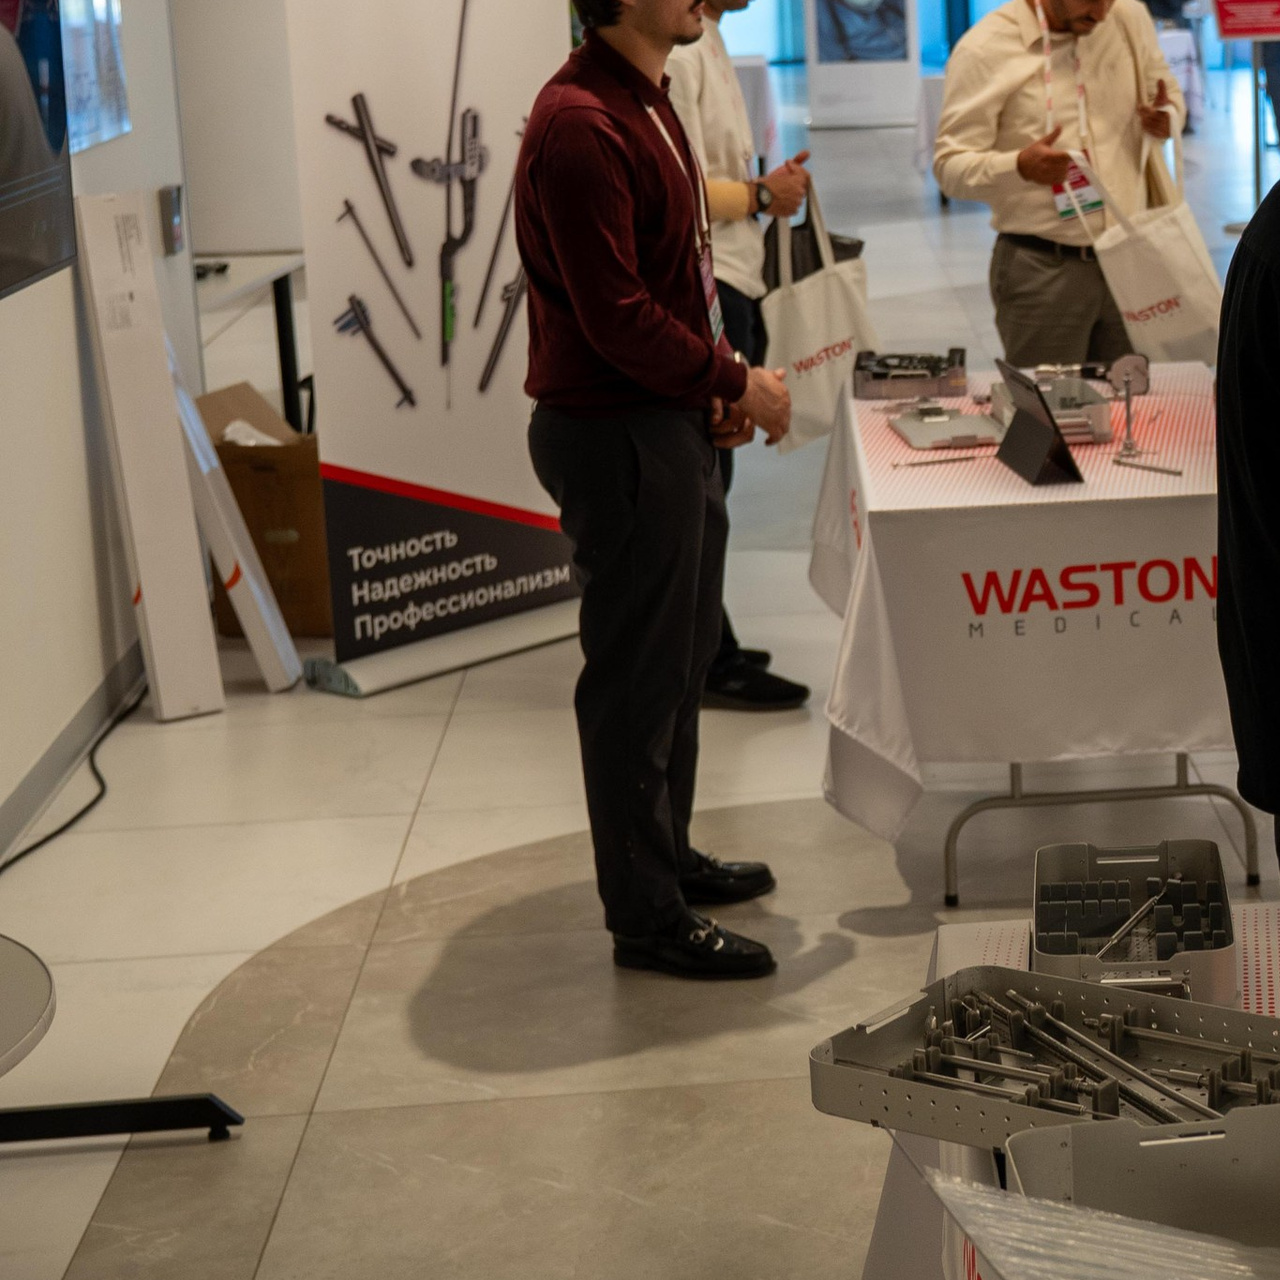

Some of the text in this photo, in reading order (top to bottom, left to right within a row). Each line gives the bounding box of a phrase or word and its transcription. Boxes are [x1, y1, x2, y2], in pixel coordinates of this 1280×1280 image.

[347, 529, 459, 572] Точность
[350, 552, 499, 607] Надежность
[353, 563, 572, 642] Профессионализм
[960, 554, 1218, 616] WASTON
